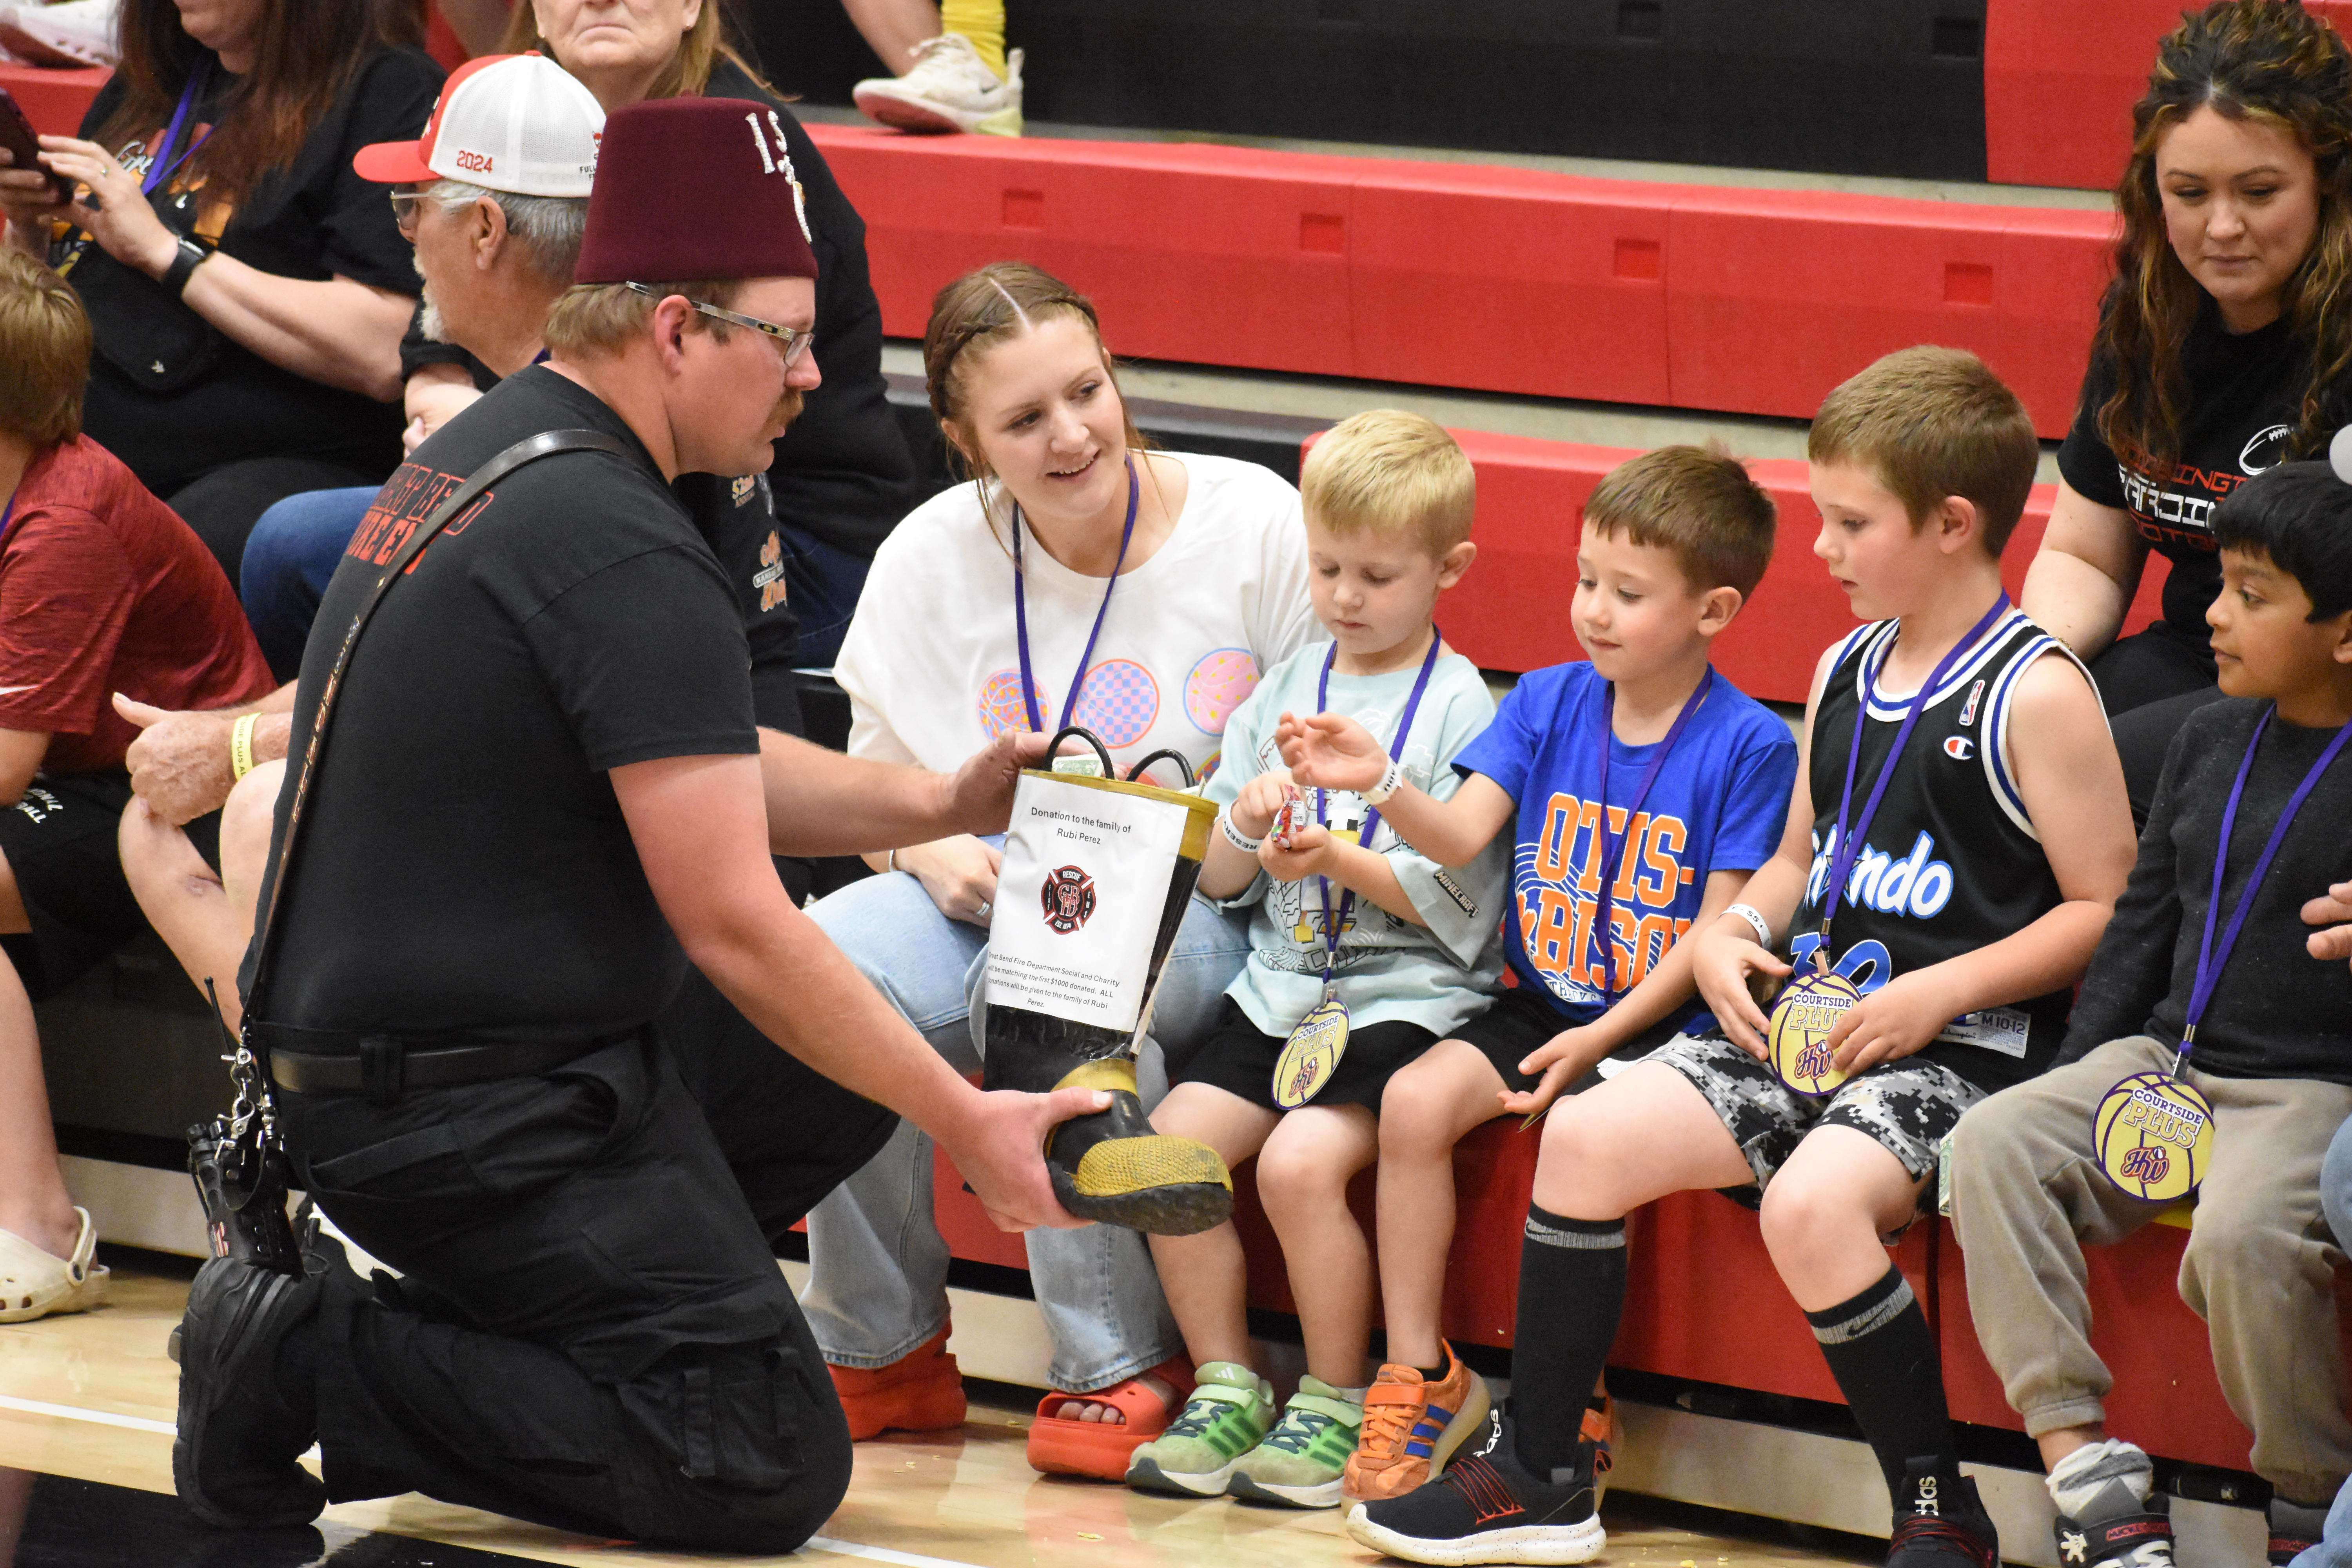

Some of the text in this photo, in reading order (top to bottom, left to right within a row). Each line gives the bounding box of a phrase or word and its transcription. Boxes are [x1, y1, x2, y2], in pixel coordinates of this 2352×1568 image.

[456, 150, 493, 173] 2024
[407, 472, 494, 536] BED
[1031, 807, 1070, 821] Donation
[1072, 815, 1080, 823] to
[1082, 817, 1094, 826] the
[1096, 819, 1120, 833] family
[1057, 828, 1101, 844] Rubi Perez
[1063, 871, 1082, 881] RESCUE
[1434, 871, 1479, 918] MINECRAFT
[1533, 887, 1696, 992] BISO
[999, 954, 1013, 962] Bend
[1027, 961, 1060, 973] Department
[1061, 968, 1079, 978] Social
[1094, 975, 1120, 987] Charity
[1002, 969, 1027, 980] matching
[1050, 977, 1069, 987] $1000
[1070, 983, 1096, 994] donated.
[1100, 989, 1114, 998] ALL
[1027, 998, 1045, 1007] Perez.
[1029, 985, 1044, 995] given
[1063, 993, 1082, 1004] family
[1091, 1000, 1108, 1009] Rubi
[1793, 994, 1851, 1008] COURTSIDE
[1298, 1015, 1339, 1039] COURTSIDE
[1982, 1014, 1993, 1026] M
[1291, 1024, 1336, 1062] PLUS
[2134, 1089, 2203, 1124] COURTSIDE
[2123, 1098, 2197, 1149] PLUS
